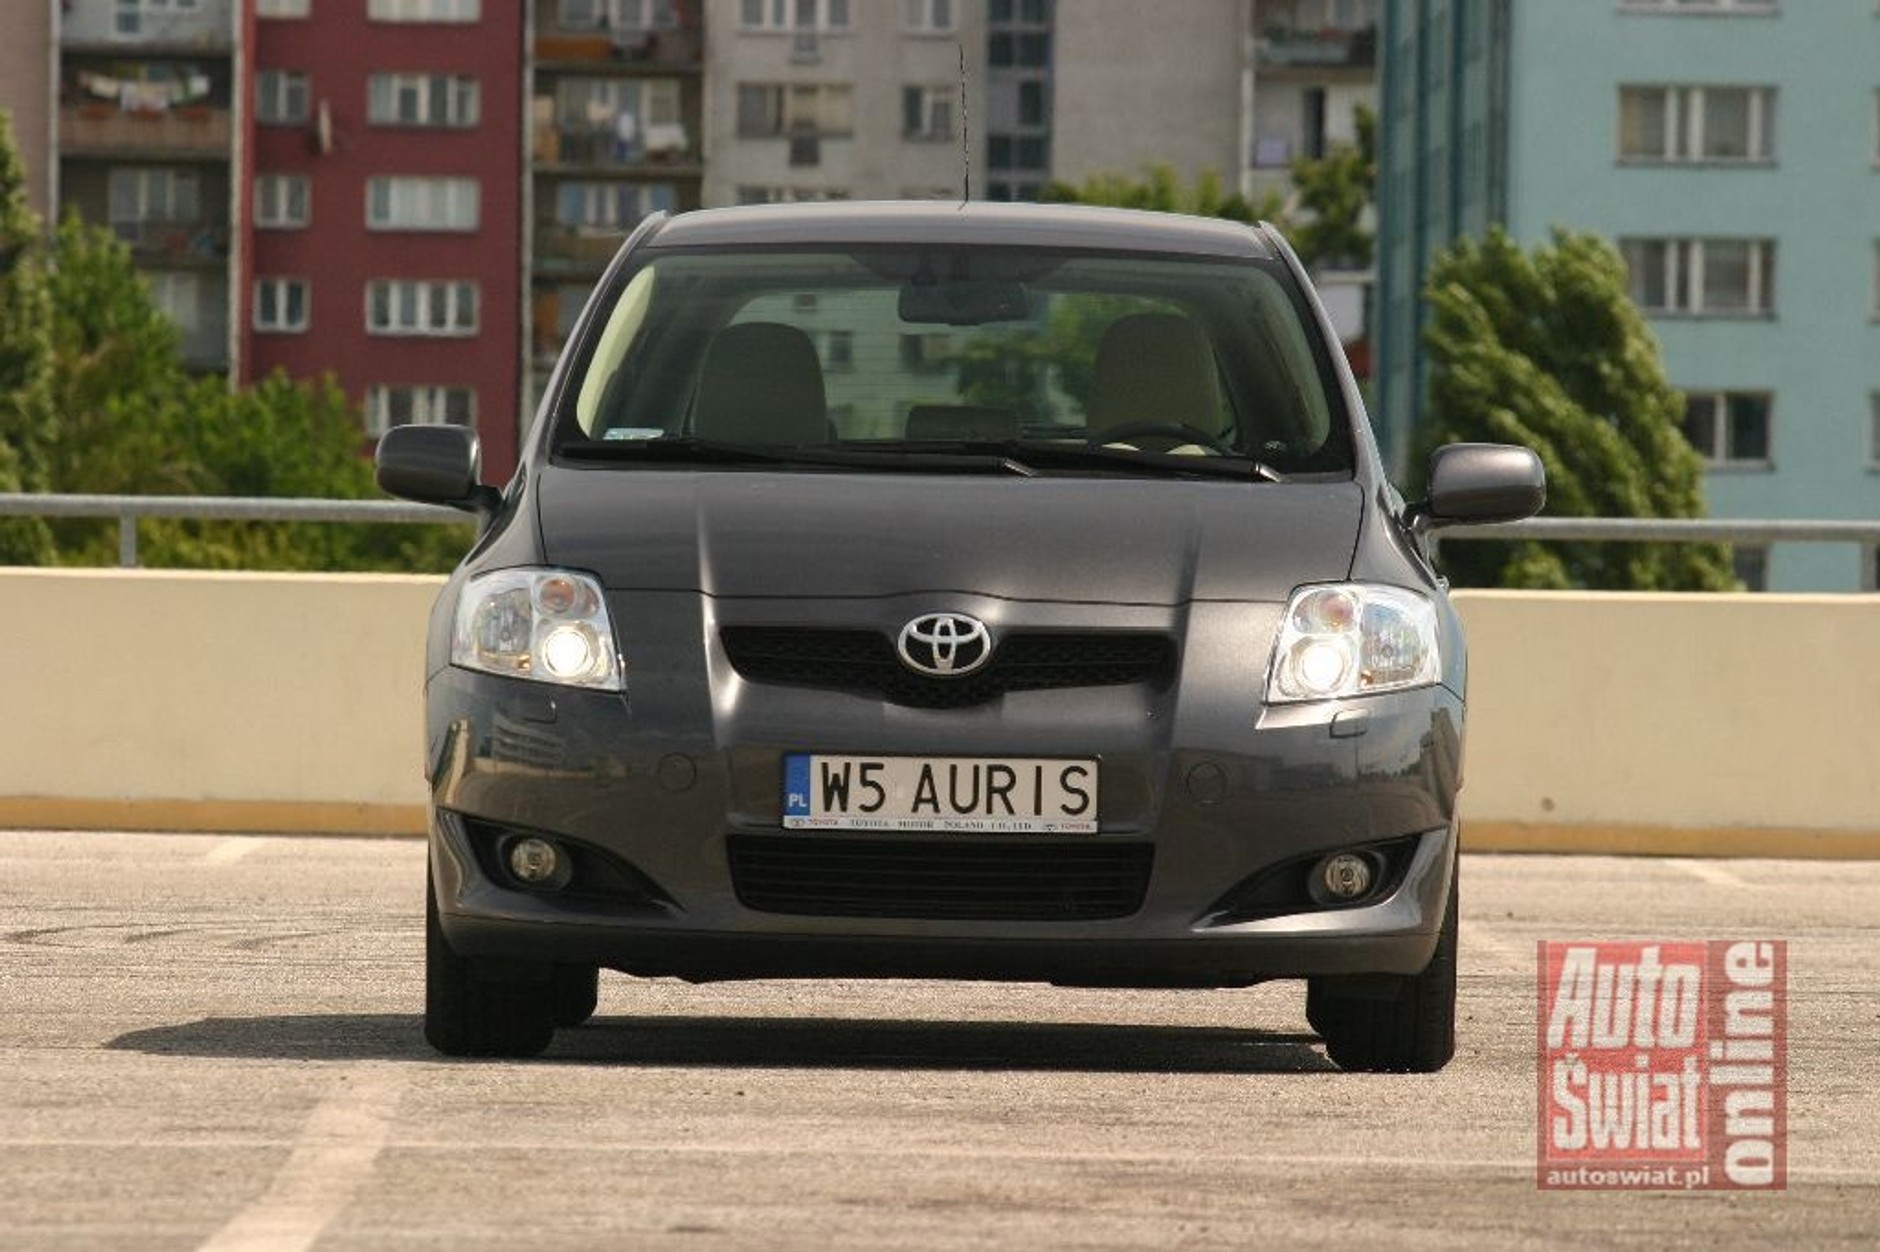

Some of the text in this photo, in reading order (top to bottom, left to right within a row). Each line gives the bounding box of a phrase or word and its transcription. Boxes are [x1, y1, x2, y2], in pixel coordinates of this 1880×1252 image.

[788, 793, 807, 807] PL
[821, 762, 1090, 816] W5 AURIS
